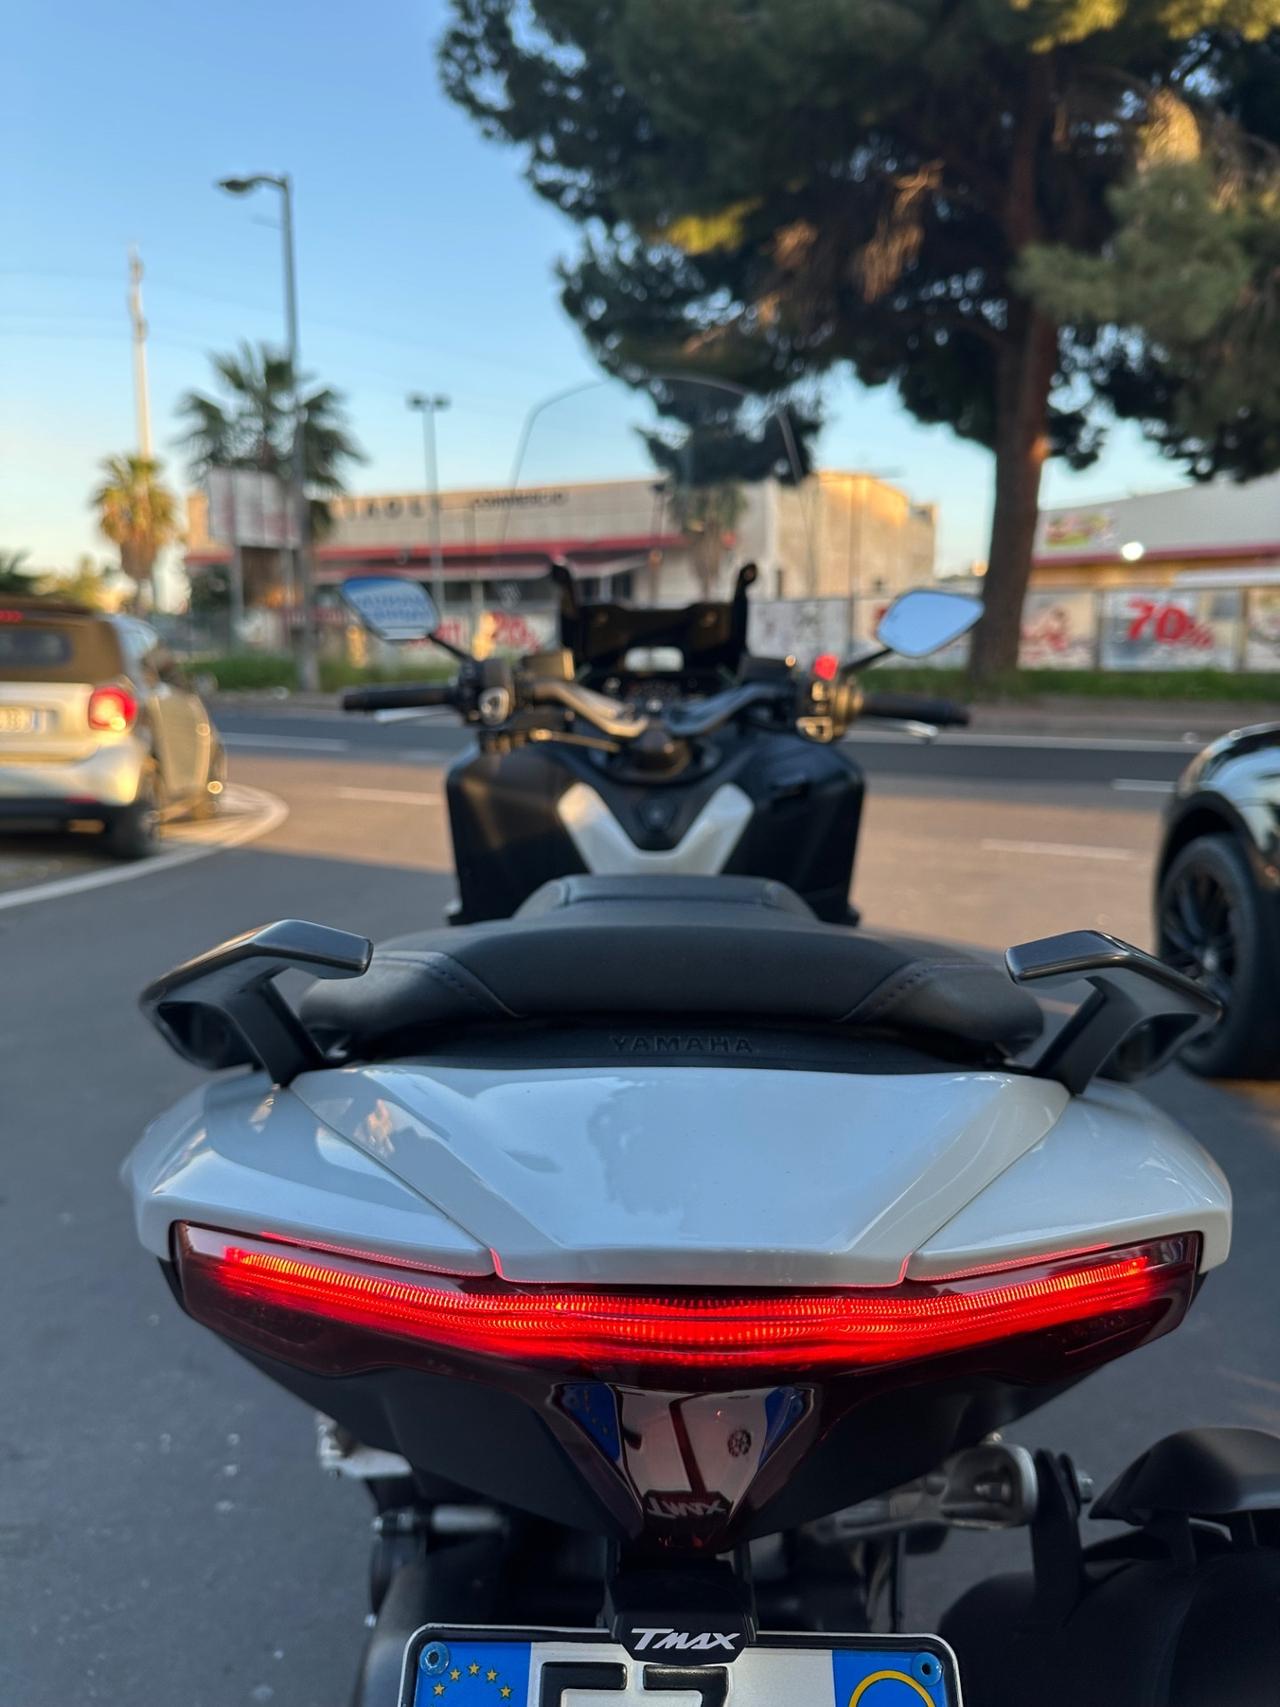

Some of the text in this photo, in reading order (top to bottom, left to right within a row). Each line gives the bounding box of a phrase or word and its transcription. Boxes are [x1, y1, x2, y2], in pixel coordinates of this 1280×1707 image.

[1127, 596, 1213, 648] 70%
[609, 1036, 755, 1053] YAMAHA
[631, 1628, 740, 1650] TMAX
